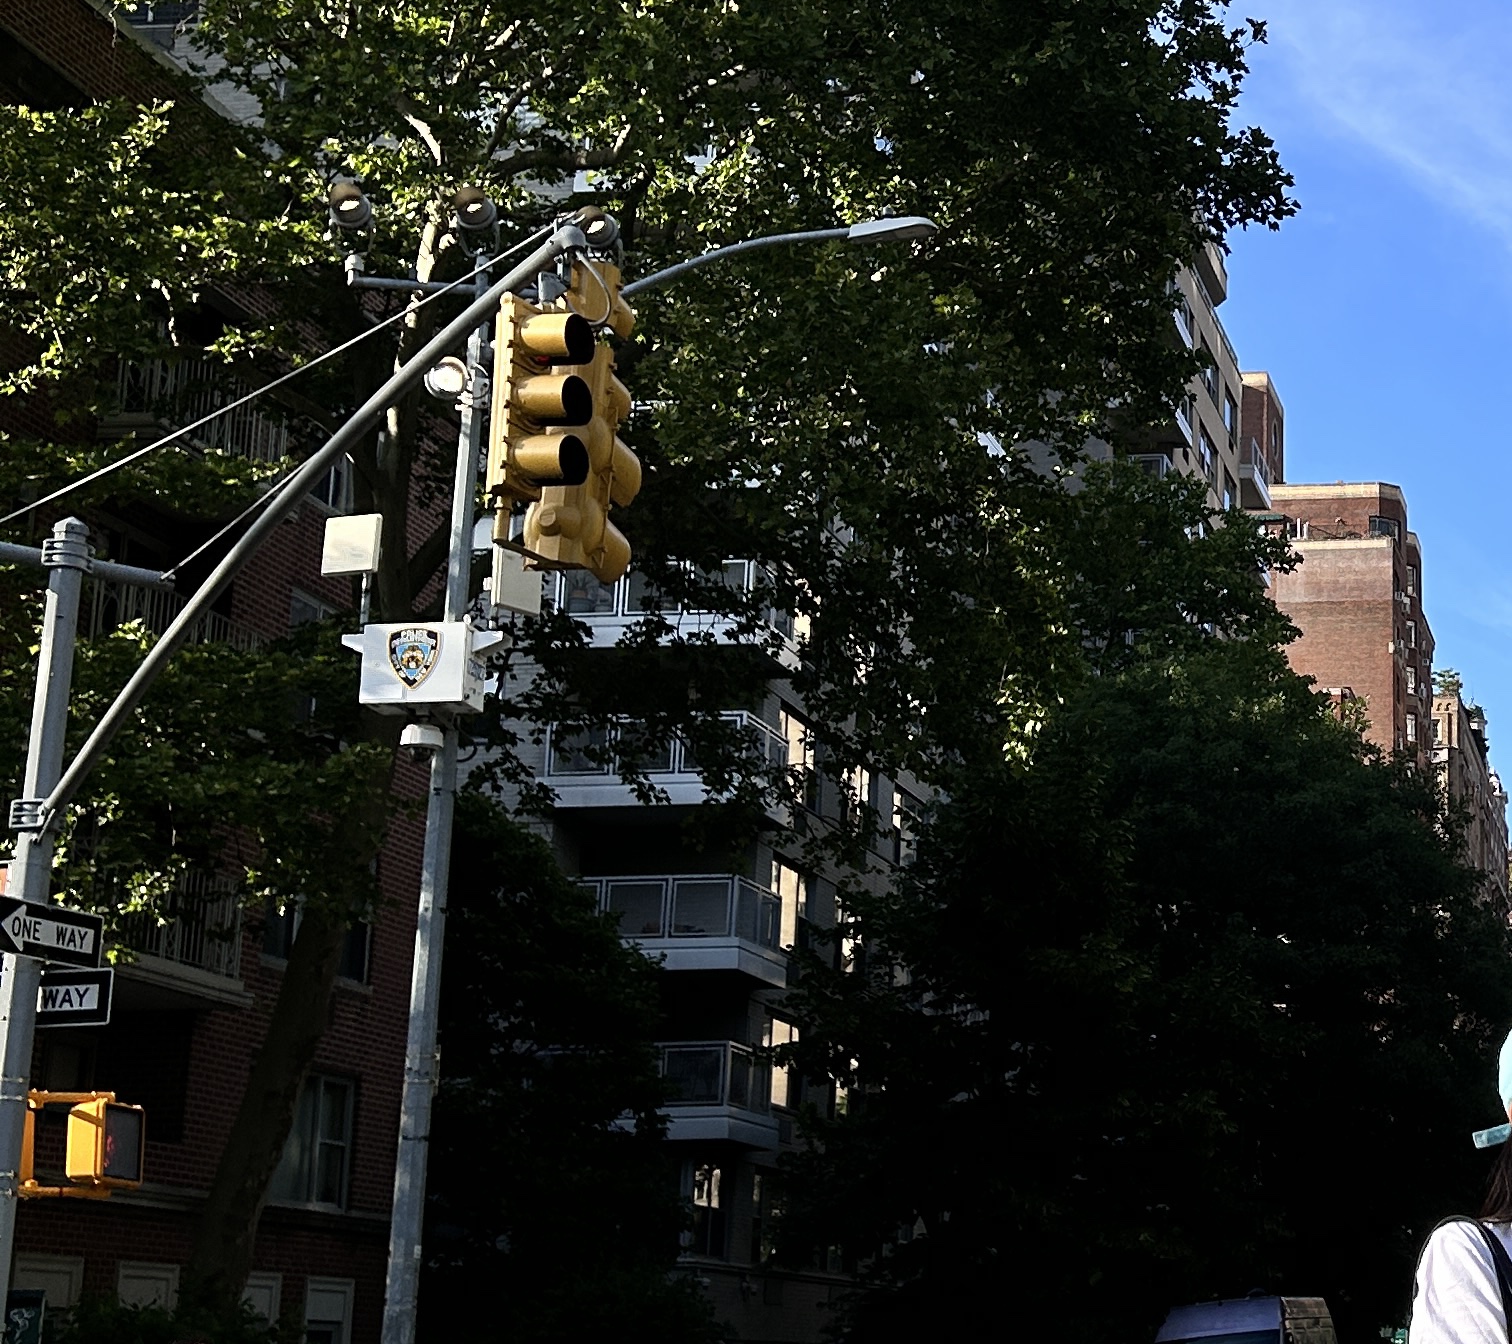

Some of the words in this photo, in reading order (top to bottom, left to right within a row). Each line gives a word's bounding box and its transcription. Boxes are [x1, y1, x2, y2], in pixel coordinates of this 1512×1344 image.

[11, 916, 42, 942] ONE
[56, 924, 88, 951] WAY
[42, 987, 90, 1009] WAY
